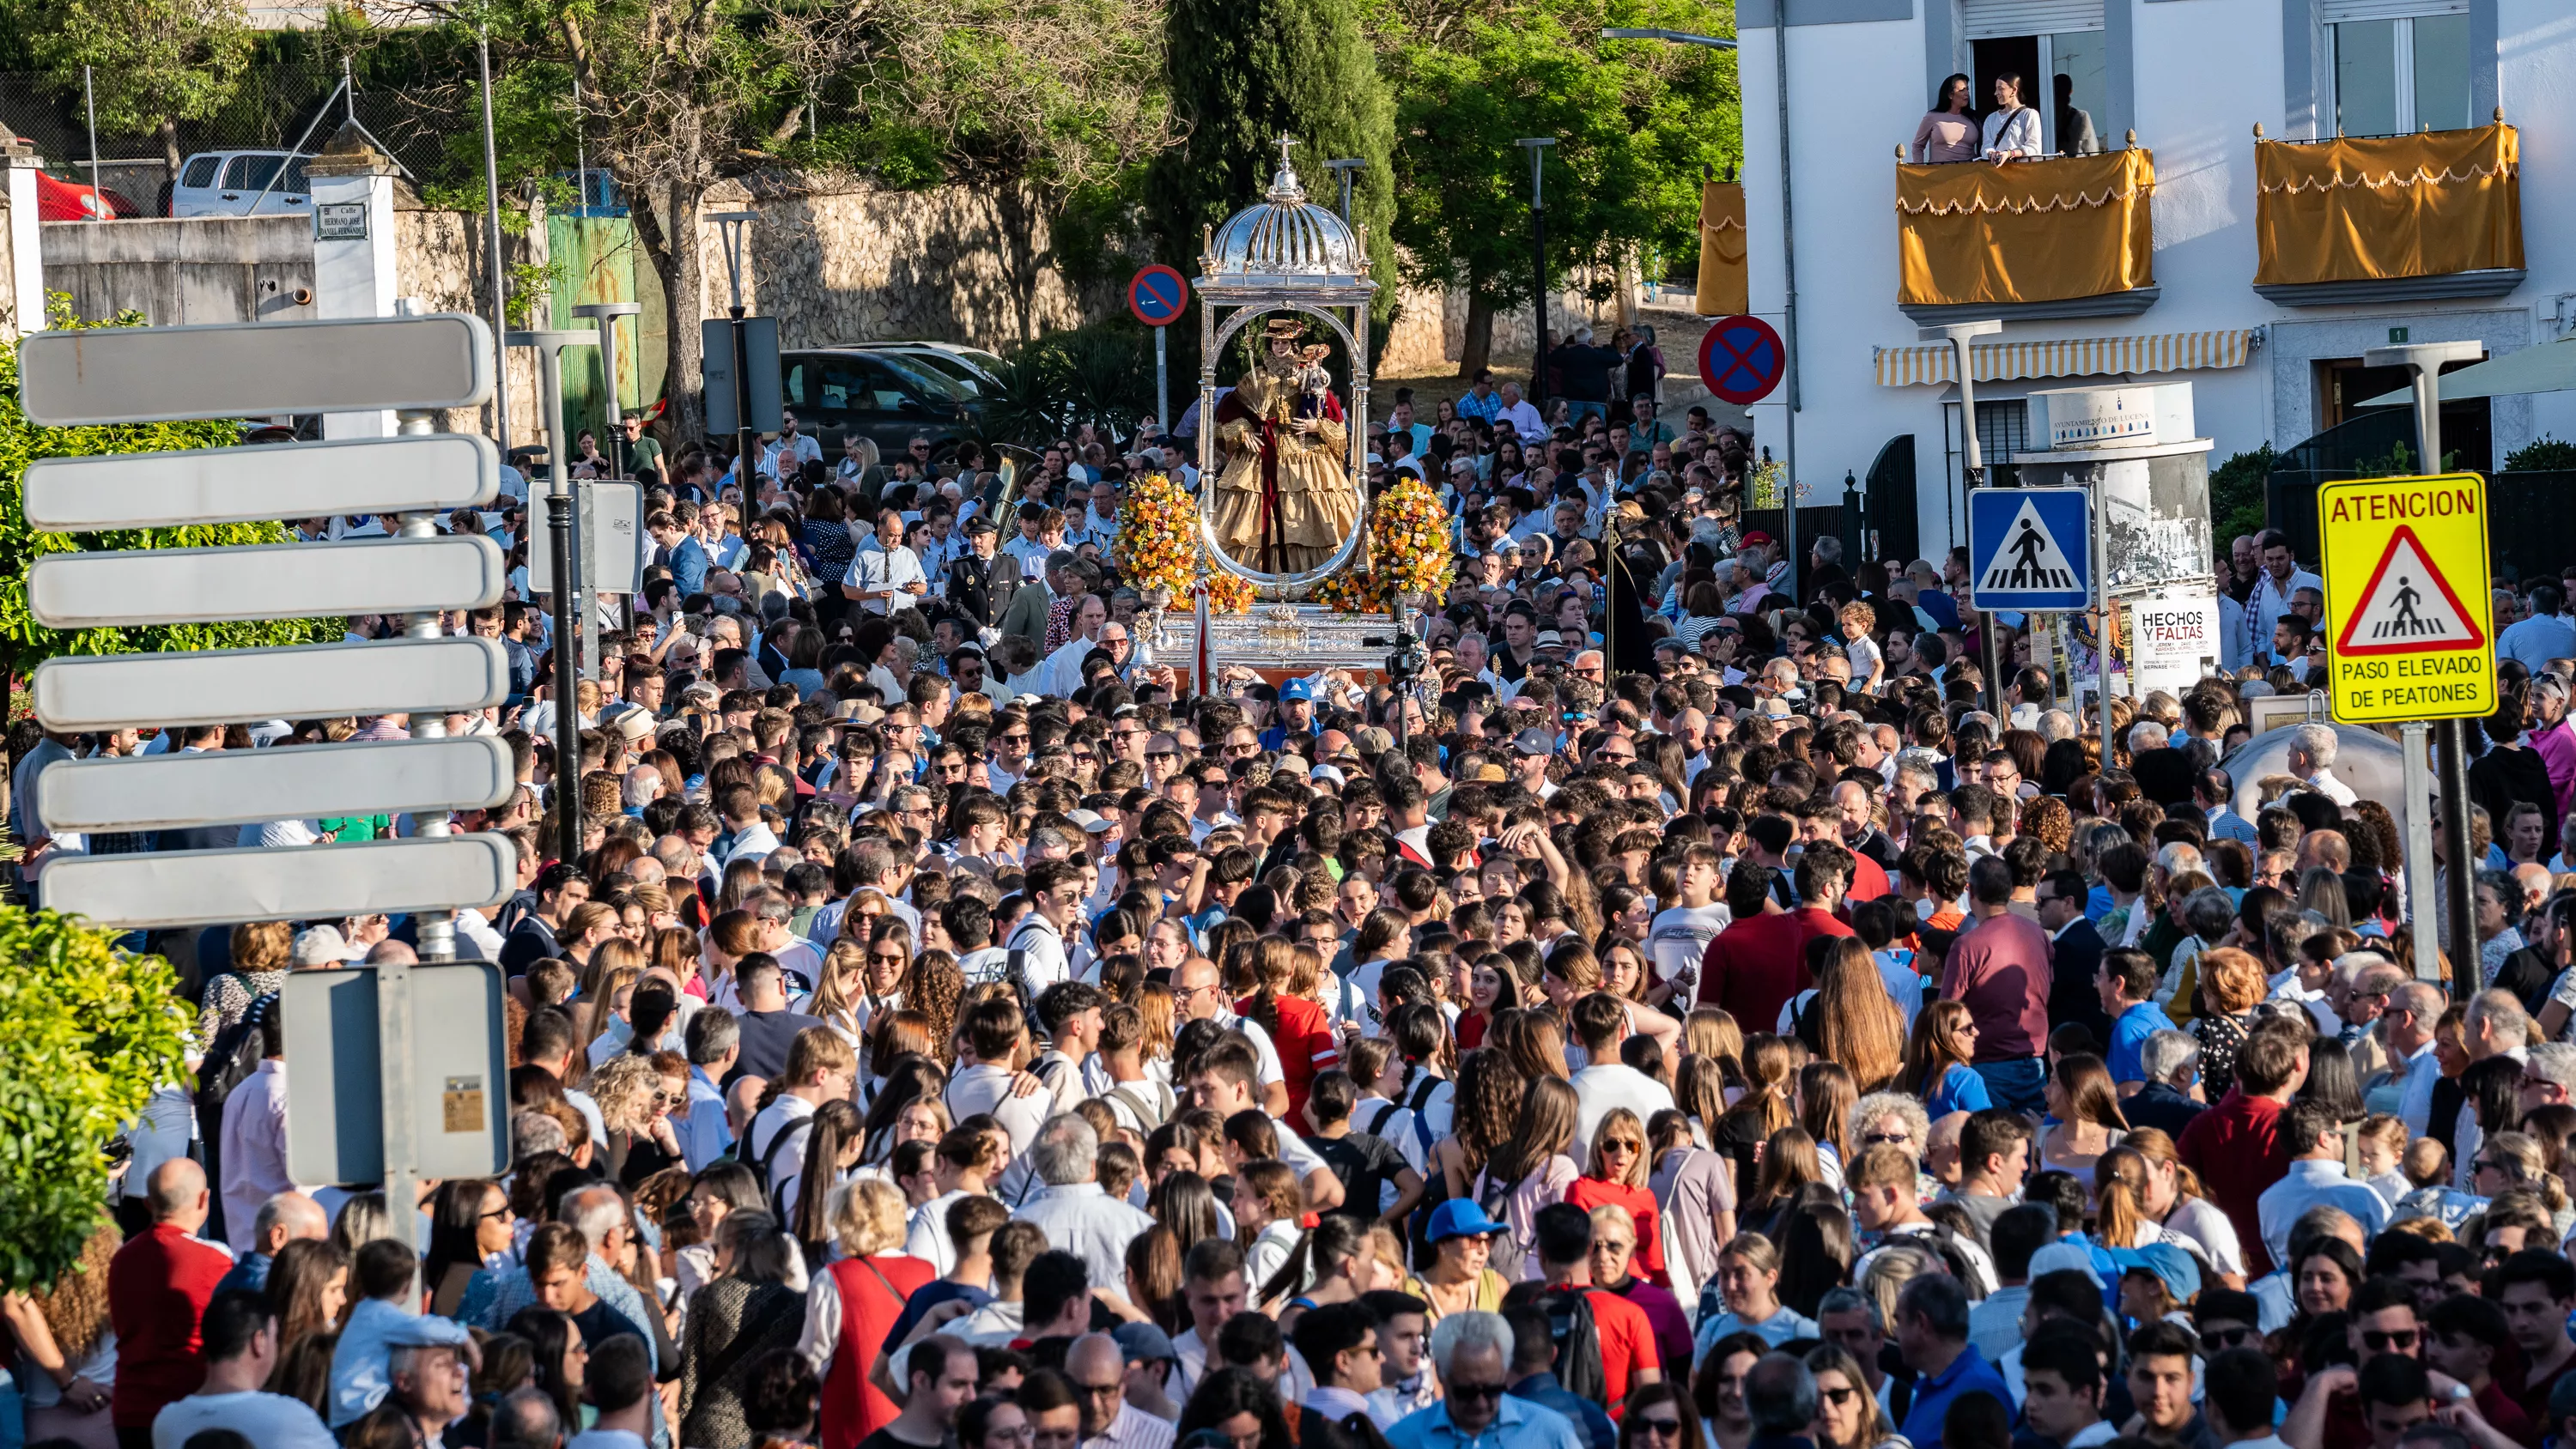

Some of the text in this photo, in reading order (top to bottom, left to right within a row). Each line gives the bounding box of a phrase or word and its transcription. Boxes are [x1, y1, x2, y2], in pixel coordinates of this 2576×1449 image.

[324, 217, 347, 226] HERMANO
[2396, 330, 2401, 341] 1
[2053, 416, 2107, 428] AYUNTAMIENTO
[2120, 412, 2149, 421] LUCENA
[2331, 488, 2476, 523] ATENCION
[2142, 611, 2203, 627] HECHOS
[2077, 627, 2099, 648] TIERR
[2143, 627, 2154, 641] Y
[2156, 626, 2203, 640] FALTAS
[2342, 656, 2482, 681] PASO ELEVADO
[2352, 683, 2477, 708] DE PEATONES
